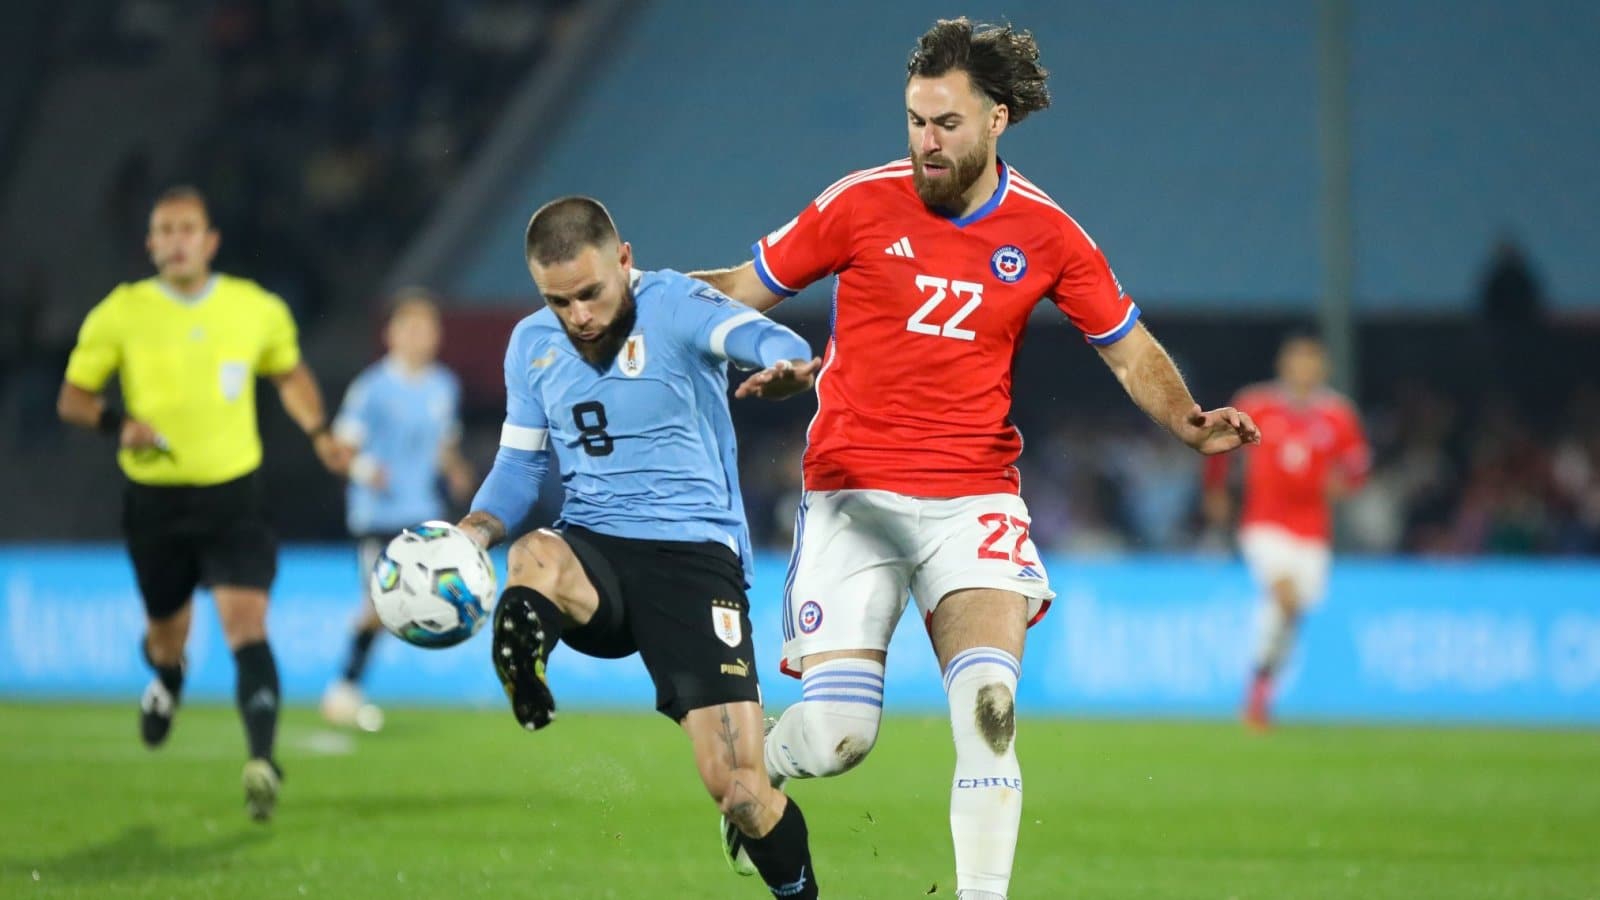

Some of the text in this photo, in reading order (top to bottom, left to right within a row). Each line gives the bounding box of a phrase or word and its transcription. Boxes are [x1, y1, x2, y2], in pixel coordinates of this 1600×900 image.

[906, 274, 984, 341] 22
[571, 400, 615, 457] 8
[977, 512, 1036, 567] 22
[957, 776, 1022, 793] CHILE
